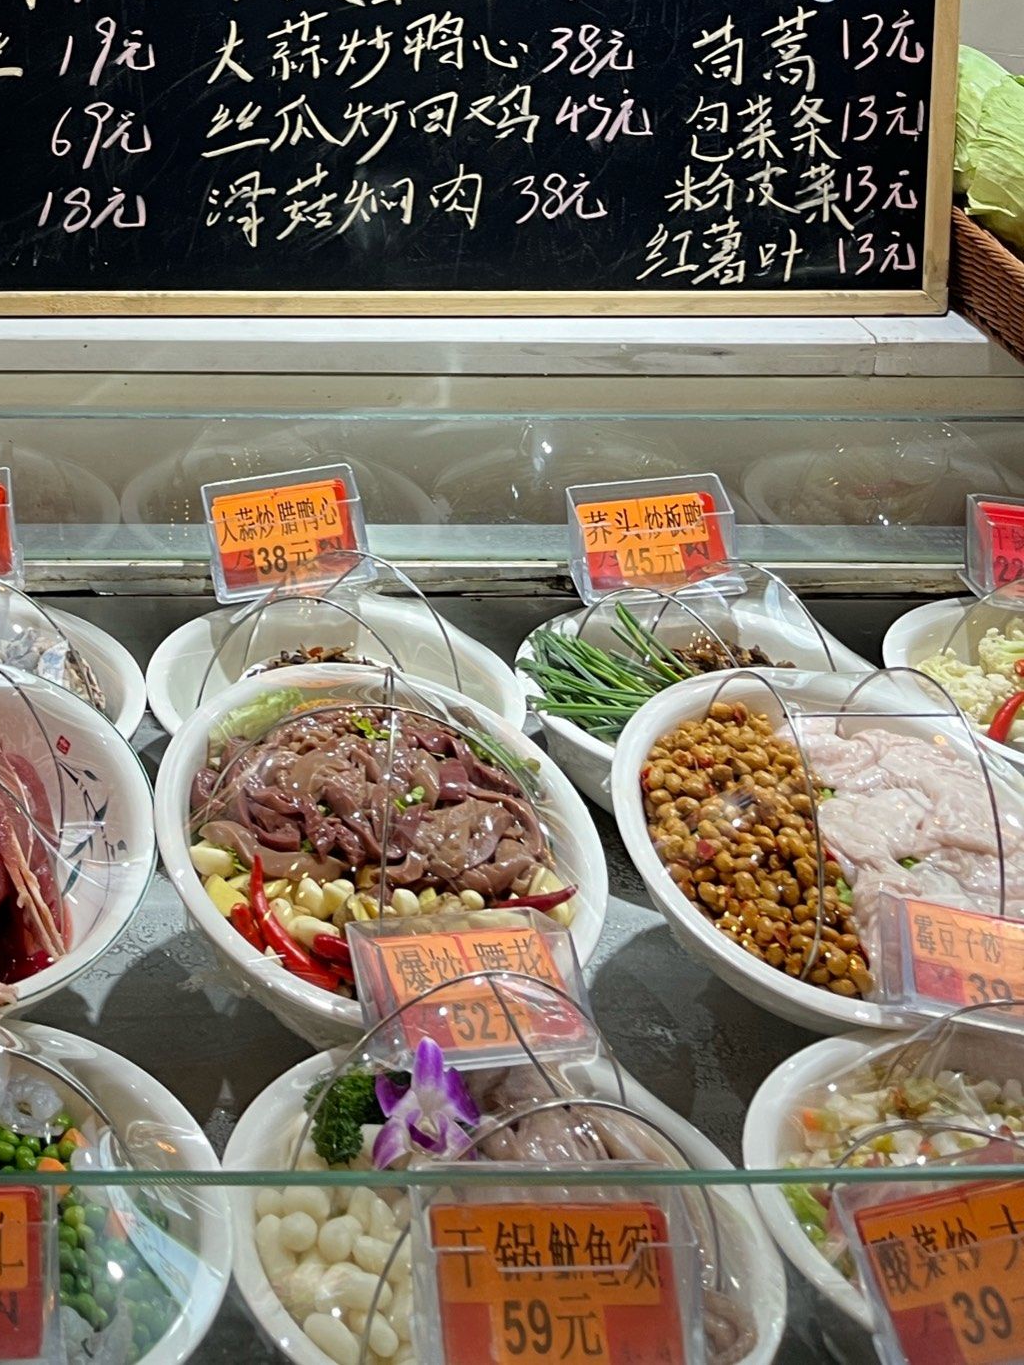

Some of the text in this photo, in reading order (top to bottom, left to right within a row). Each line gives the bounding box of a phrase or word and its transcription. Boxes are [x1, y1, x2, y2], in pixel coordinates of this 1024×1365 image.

[258, 540, 314, 575] 38元
[623, 546, 685, 576] 45元
[444, 1220, 662, 1291] 干锅鱿鱼须
[503, 1294, 602, 1360] 59元
